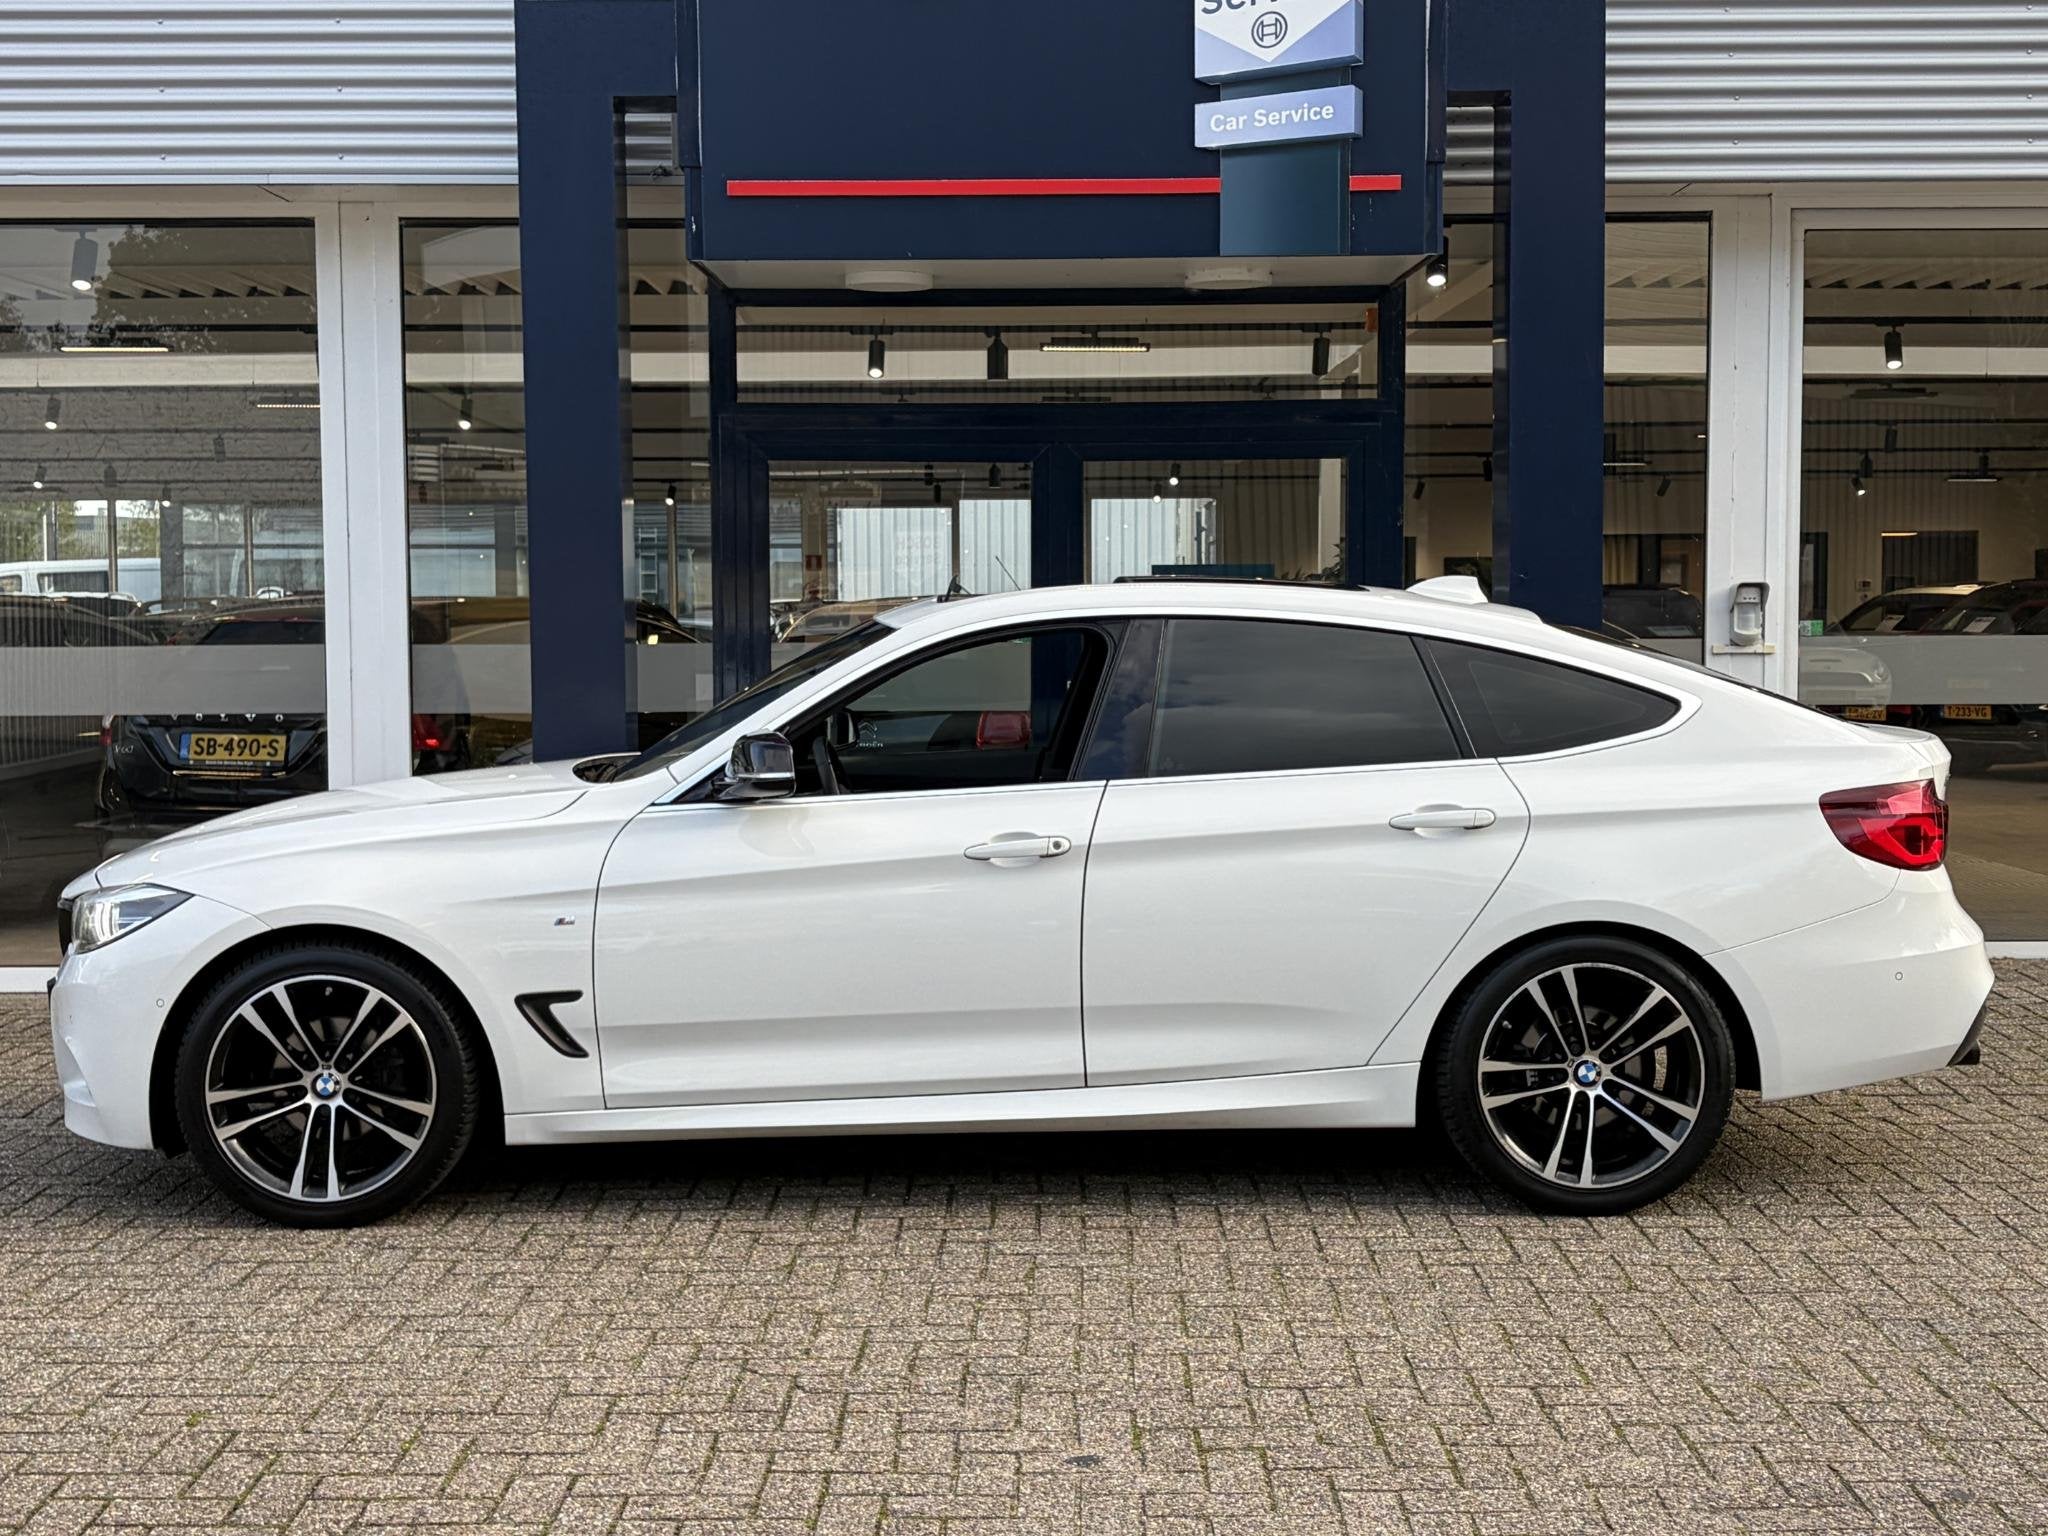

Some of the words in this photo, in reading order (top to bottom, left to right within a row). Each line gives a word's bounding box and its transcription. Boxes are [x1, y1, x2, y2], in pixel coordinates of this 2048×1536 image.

[1210, 114, 1248, 132] Car
[1253, 103, 1335, 127] Service
[193, 737, 280, 757] SB-490-S
